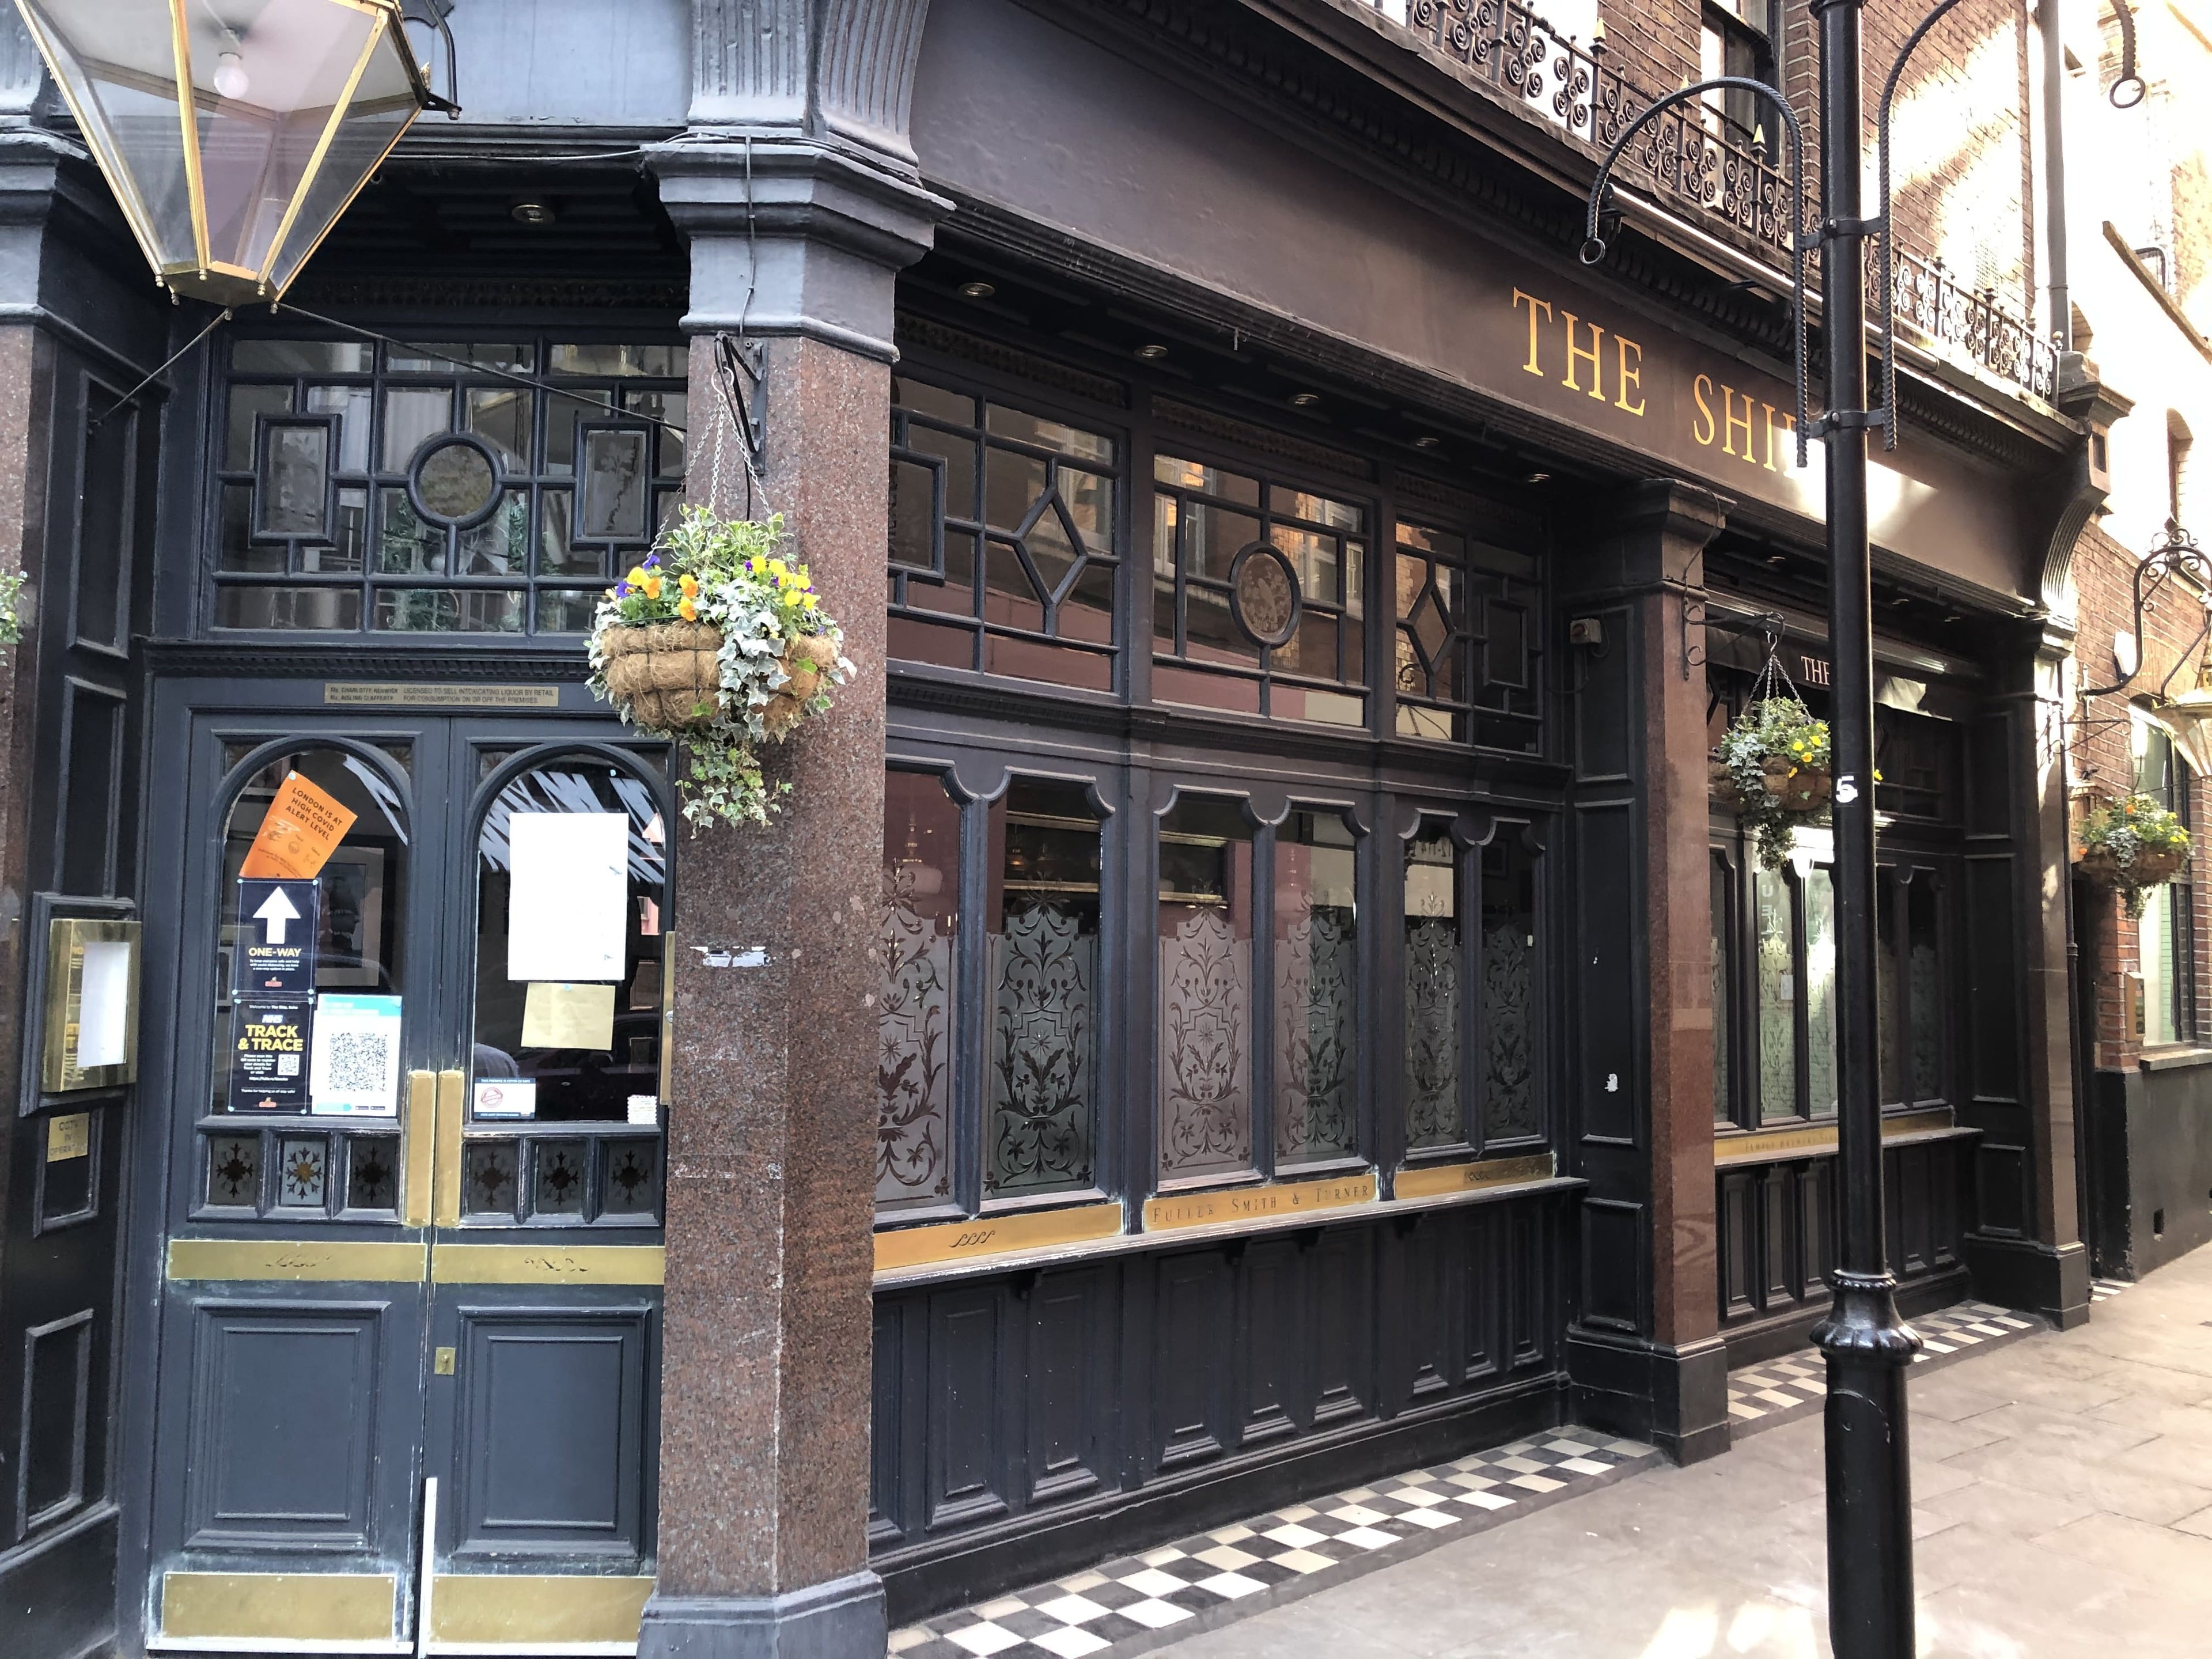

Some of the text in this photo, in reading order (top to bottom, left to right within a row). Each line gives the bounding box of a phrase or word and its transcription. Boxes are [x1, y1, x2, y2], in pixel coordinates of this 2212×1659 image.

[1513, 287, 1646, 417] THE
[1835, 775, 1858, 803] 5
[291, 797, 334, 832] HIGH COVID
[292, 787, 343, 826] LONDON IS AT
[286, 805, 310, 823] ALERT
[310, 821, 331, 840] LEVEL
[248, 947, 302, 957] ONE-WAY
[245, 1024, 298, 1038] TRACK
[262, 1014, 284, 1024] NHS
[237, 1037, 304, 1051] & TRACE
[1153, 1204, 1214, 1223] FULLER
[1232, 1195, 1277, 1213] SMITH
[1292, 1192, 1300, 1205] &
